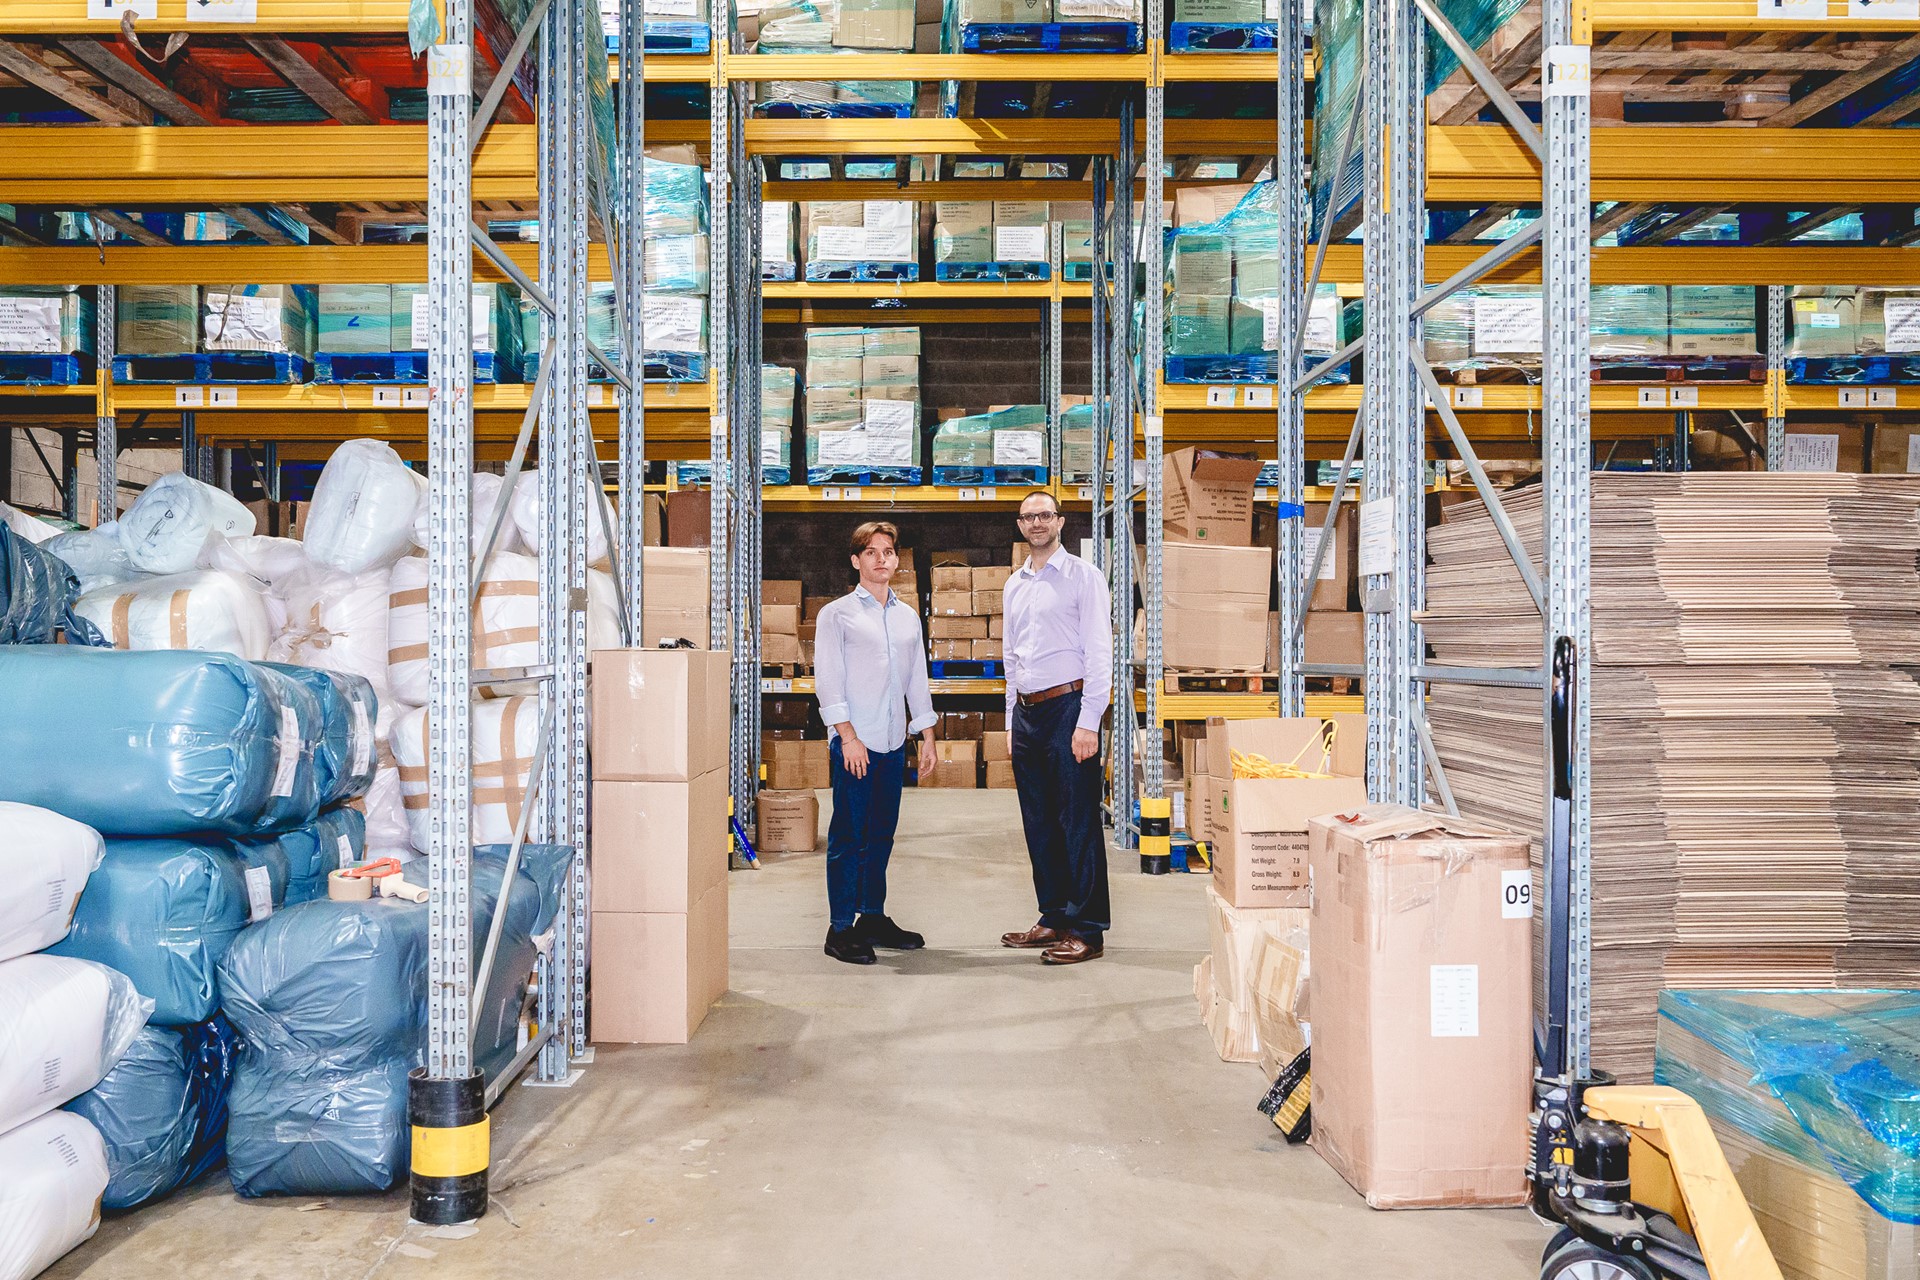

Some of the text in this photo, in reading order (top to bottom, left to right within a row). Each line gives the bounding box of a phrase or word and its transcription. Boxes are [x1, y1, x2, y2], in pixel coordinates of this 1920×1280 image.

[430, 59, 465, 77] 122
[1556, 63, 1590, 81] 121
[1266, 871, 1282, 879] Weight:
[1505, 884, 1530, 904] 09
